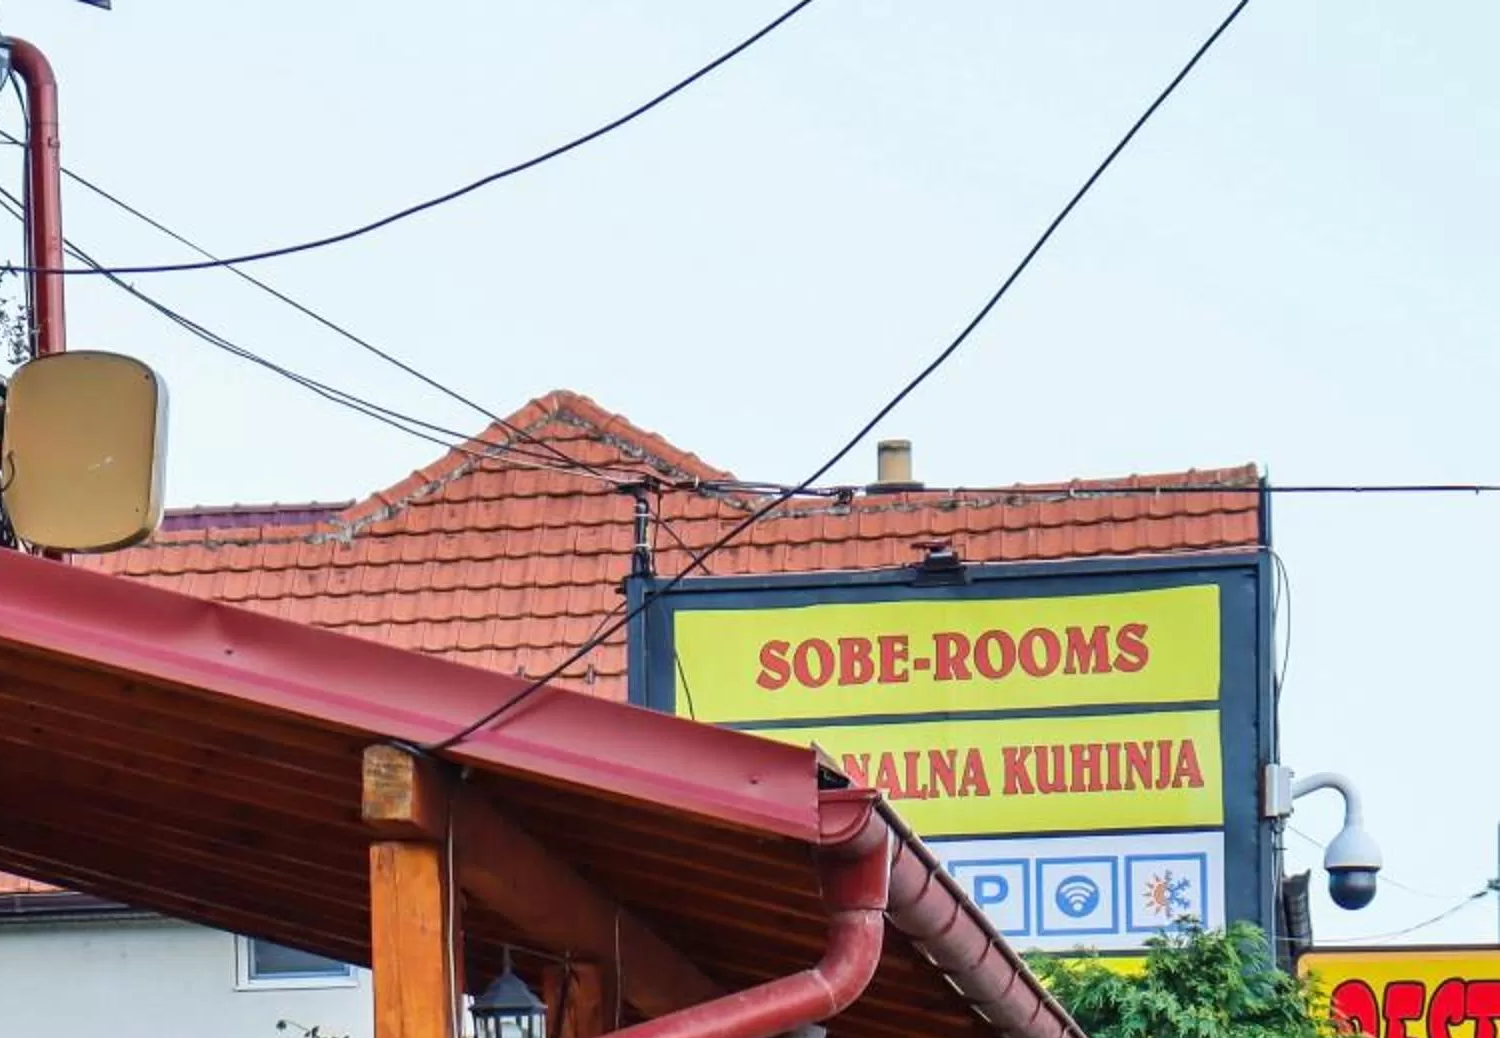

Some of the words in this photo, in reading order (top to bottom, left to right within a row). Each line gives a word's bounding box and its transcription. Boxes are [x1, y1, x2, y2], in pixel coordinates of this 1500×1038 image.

[756, 623, 1149, 690] SOBE-ROOMS
[1002, 739, 1204, 794] KUHINJA
[973, 875, 1009, 910] P
